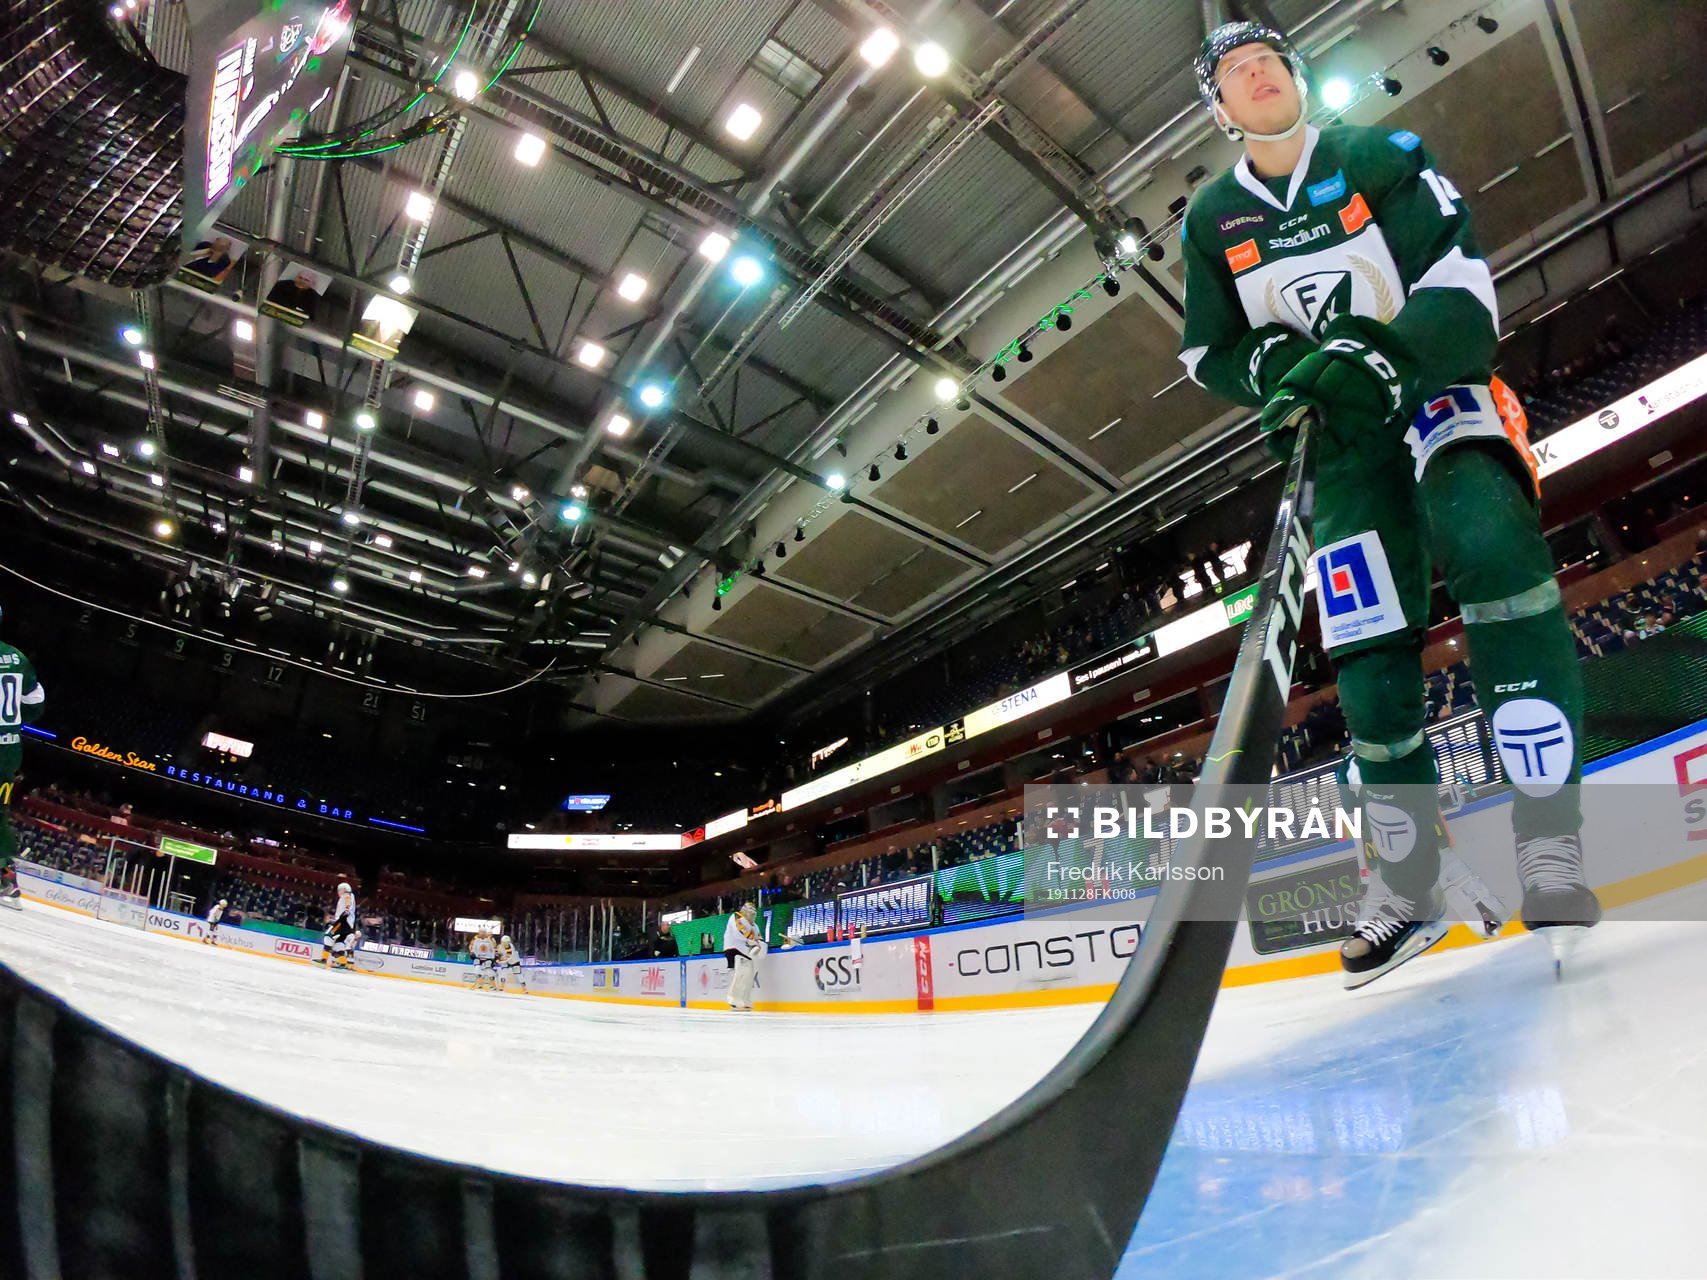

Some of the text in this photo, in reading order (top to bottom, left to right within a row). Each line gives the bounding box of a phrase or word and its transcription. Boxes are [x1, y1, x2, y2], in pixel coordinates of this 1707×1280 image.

[1220, 215, 1264, 231] LÖFBERGS
[1279, 214, 1308, 231] CCM
[1269, 223, 1331, 249] Stadium
[267, 667, 284, 681] 17
[1495, 679, 1537, 693] CCM
[1001, 688, 1038, 713] STENA
[71, 736, 156, 771] Golden Star
[167, 765, 352, 819] RESTAURANG & BAR
[787, 901, 835, 937] JOHAN
[841, 882, 928, 931] IVARSSON
[276, 941, 312, 957] JULA
[914, 940, 930, 995] CCM
